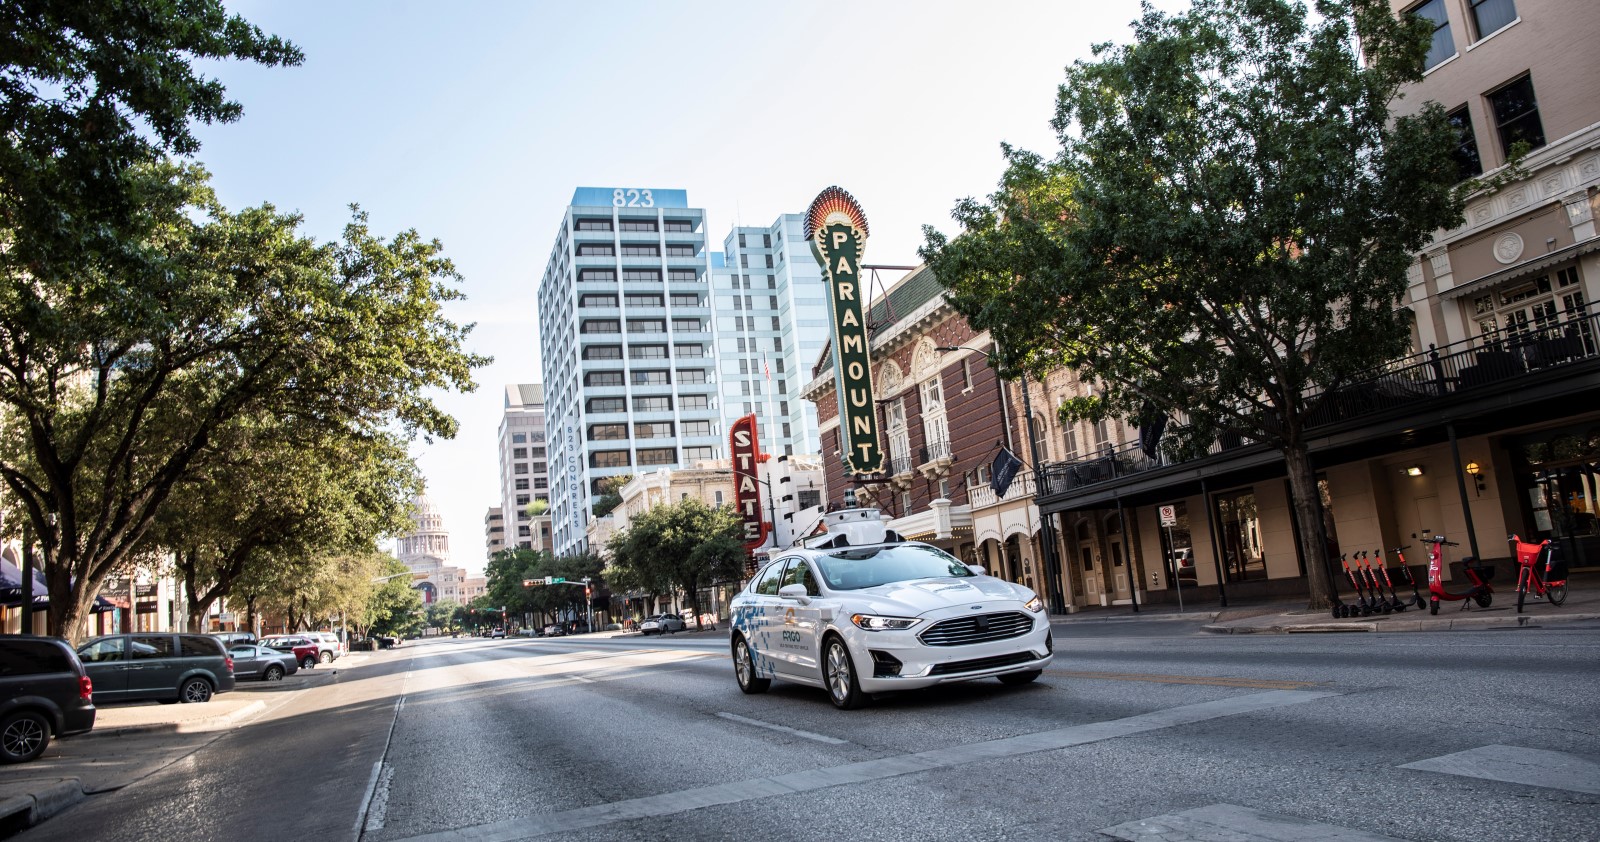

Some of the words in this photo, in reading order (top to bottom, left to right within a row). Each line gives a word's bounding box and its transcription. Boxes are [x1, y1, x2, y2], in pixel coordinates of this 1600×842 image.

[612, 188, 654, 208] 823
[832, 231, 873, 463] PARAMOUNT
[568, 456, 579, 528] CONGRESS
[734, 430, 761, 540] STATE
[782, 630, 801, 642] ARGO
